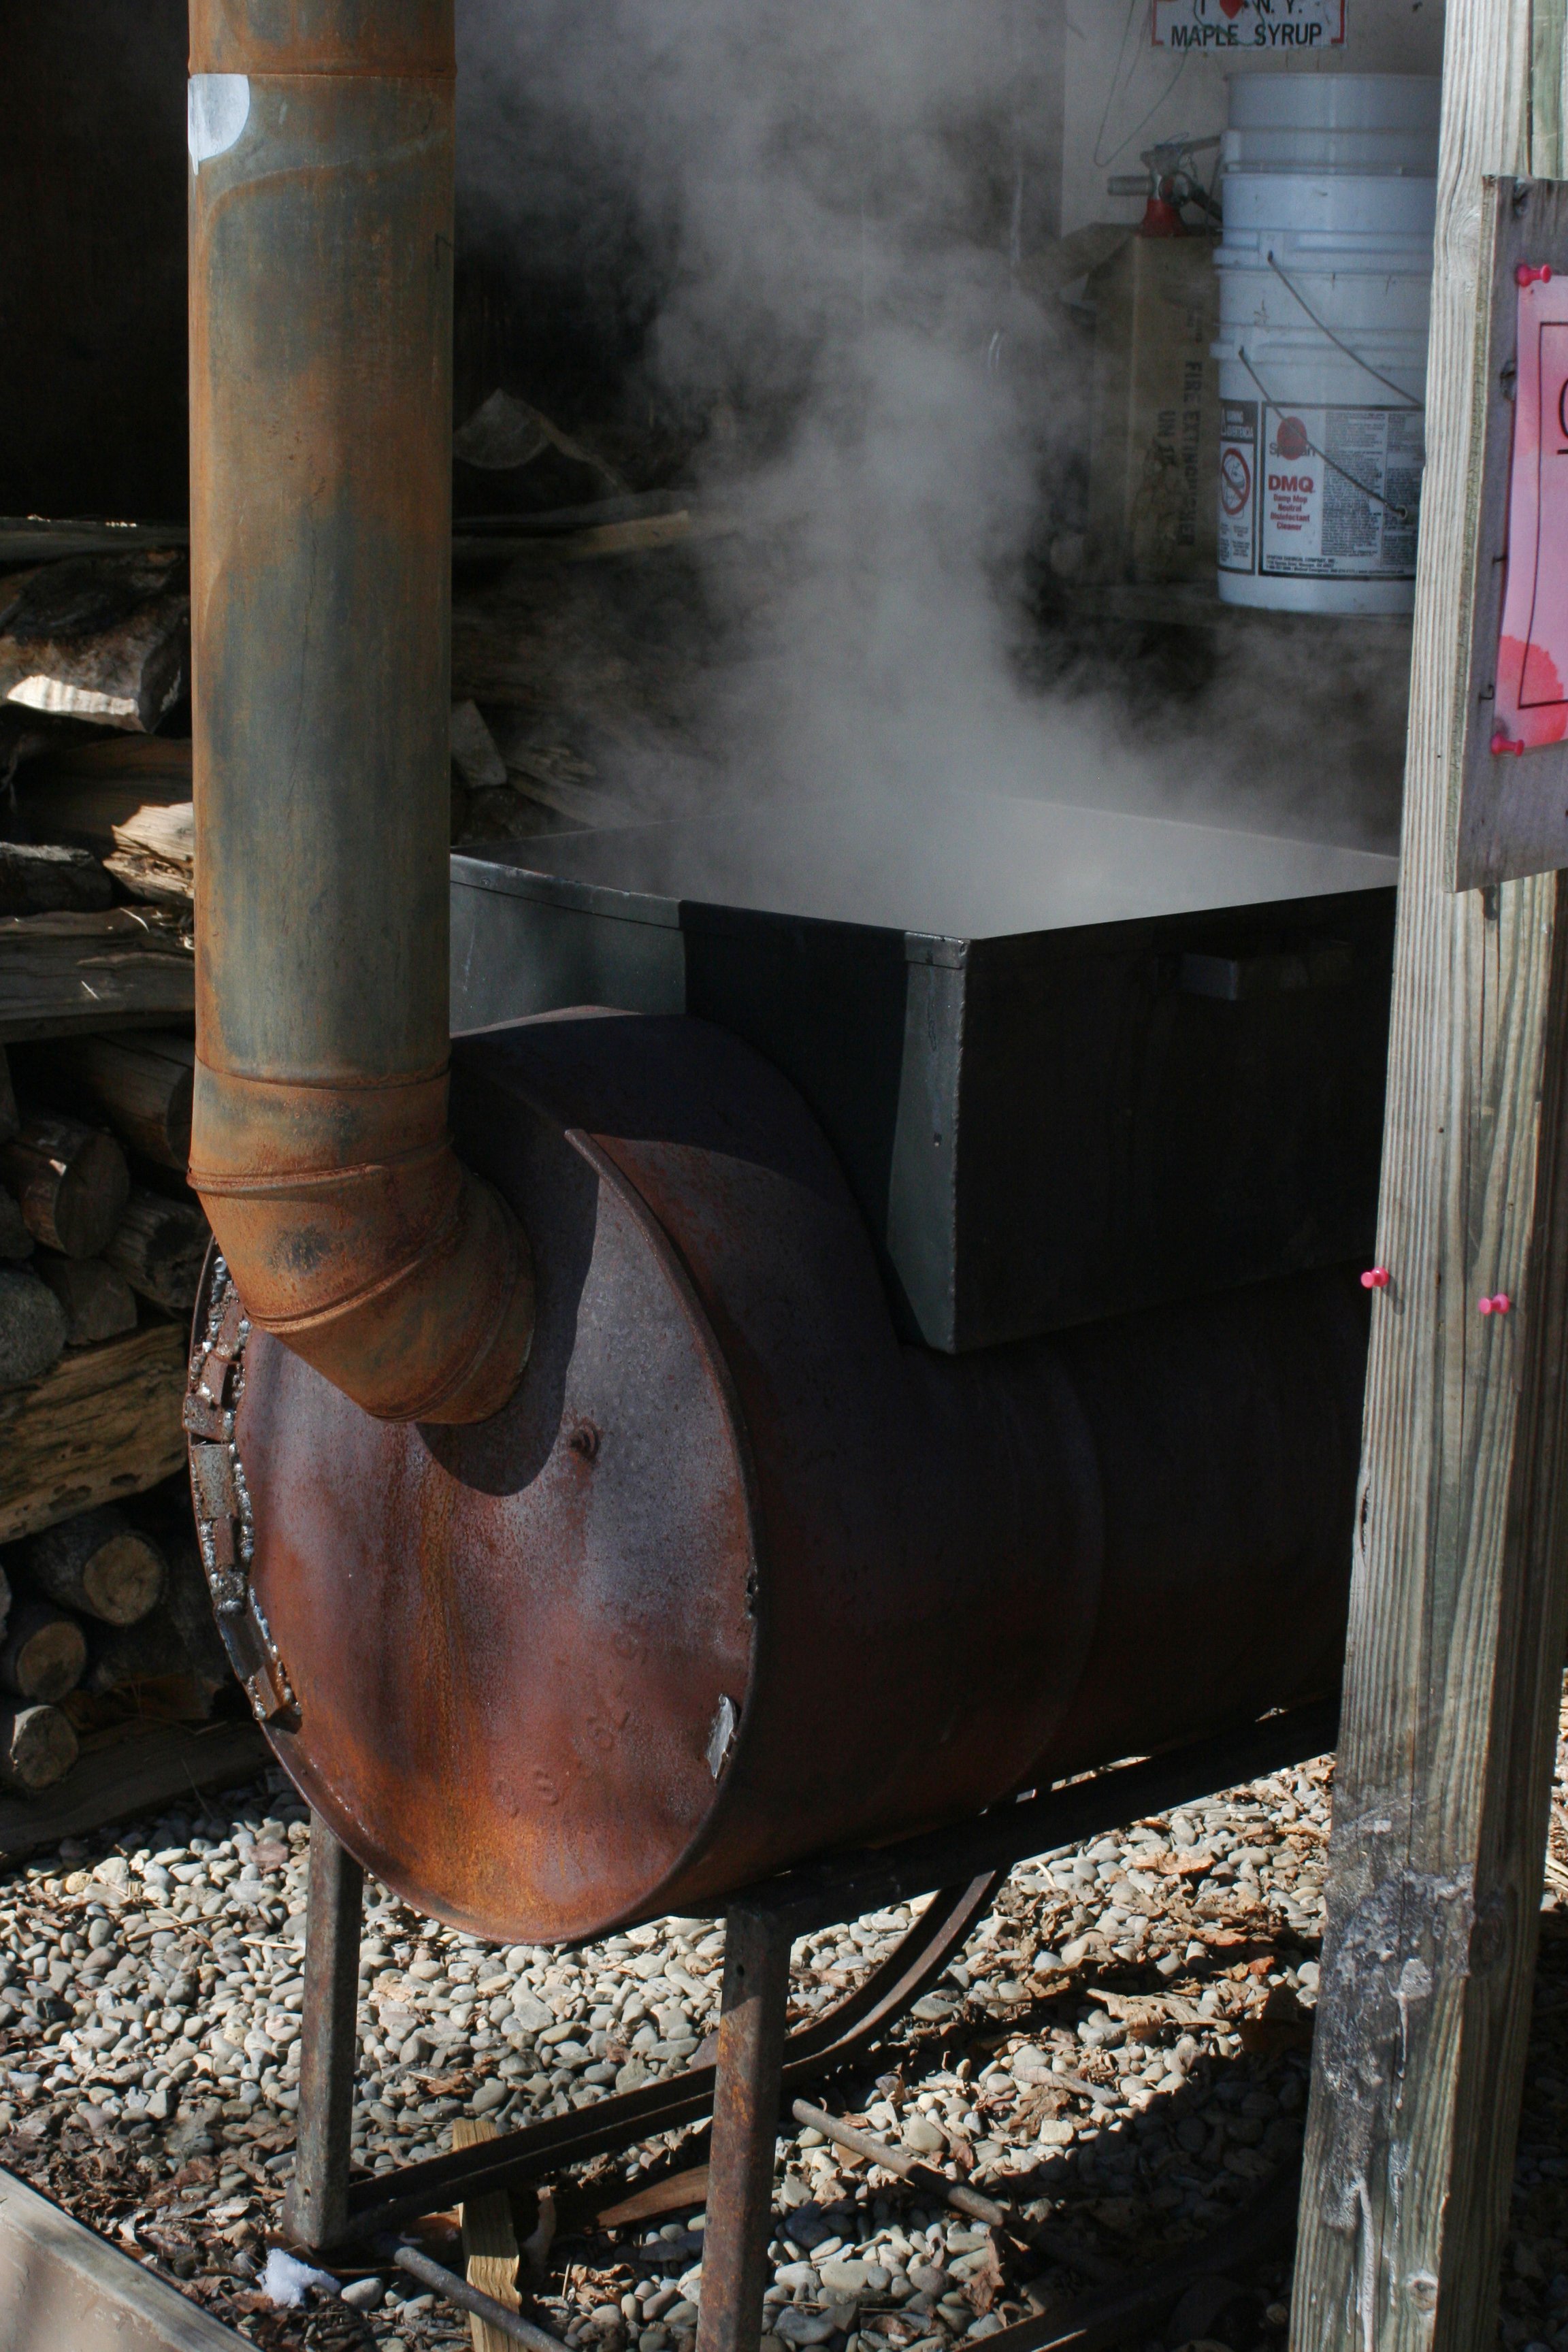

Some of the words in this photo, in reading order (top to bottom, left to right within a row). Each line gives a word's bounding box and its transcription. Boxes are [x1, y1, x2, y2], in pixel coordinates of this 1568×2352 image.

[1171, 24, 1239, 47] MAPLE
[1254, 22, 1322, 46] SYRUP
[1183, 361, 1203, 404] FIRE
[1268, 474, 1314, 493] DMQ
[1293, 495, 1308, 504] Mop
